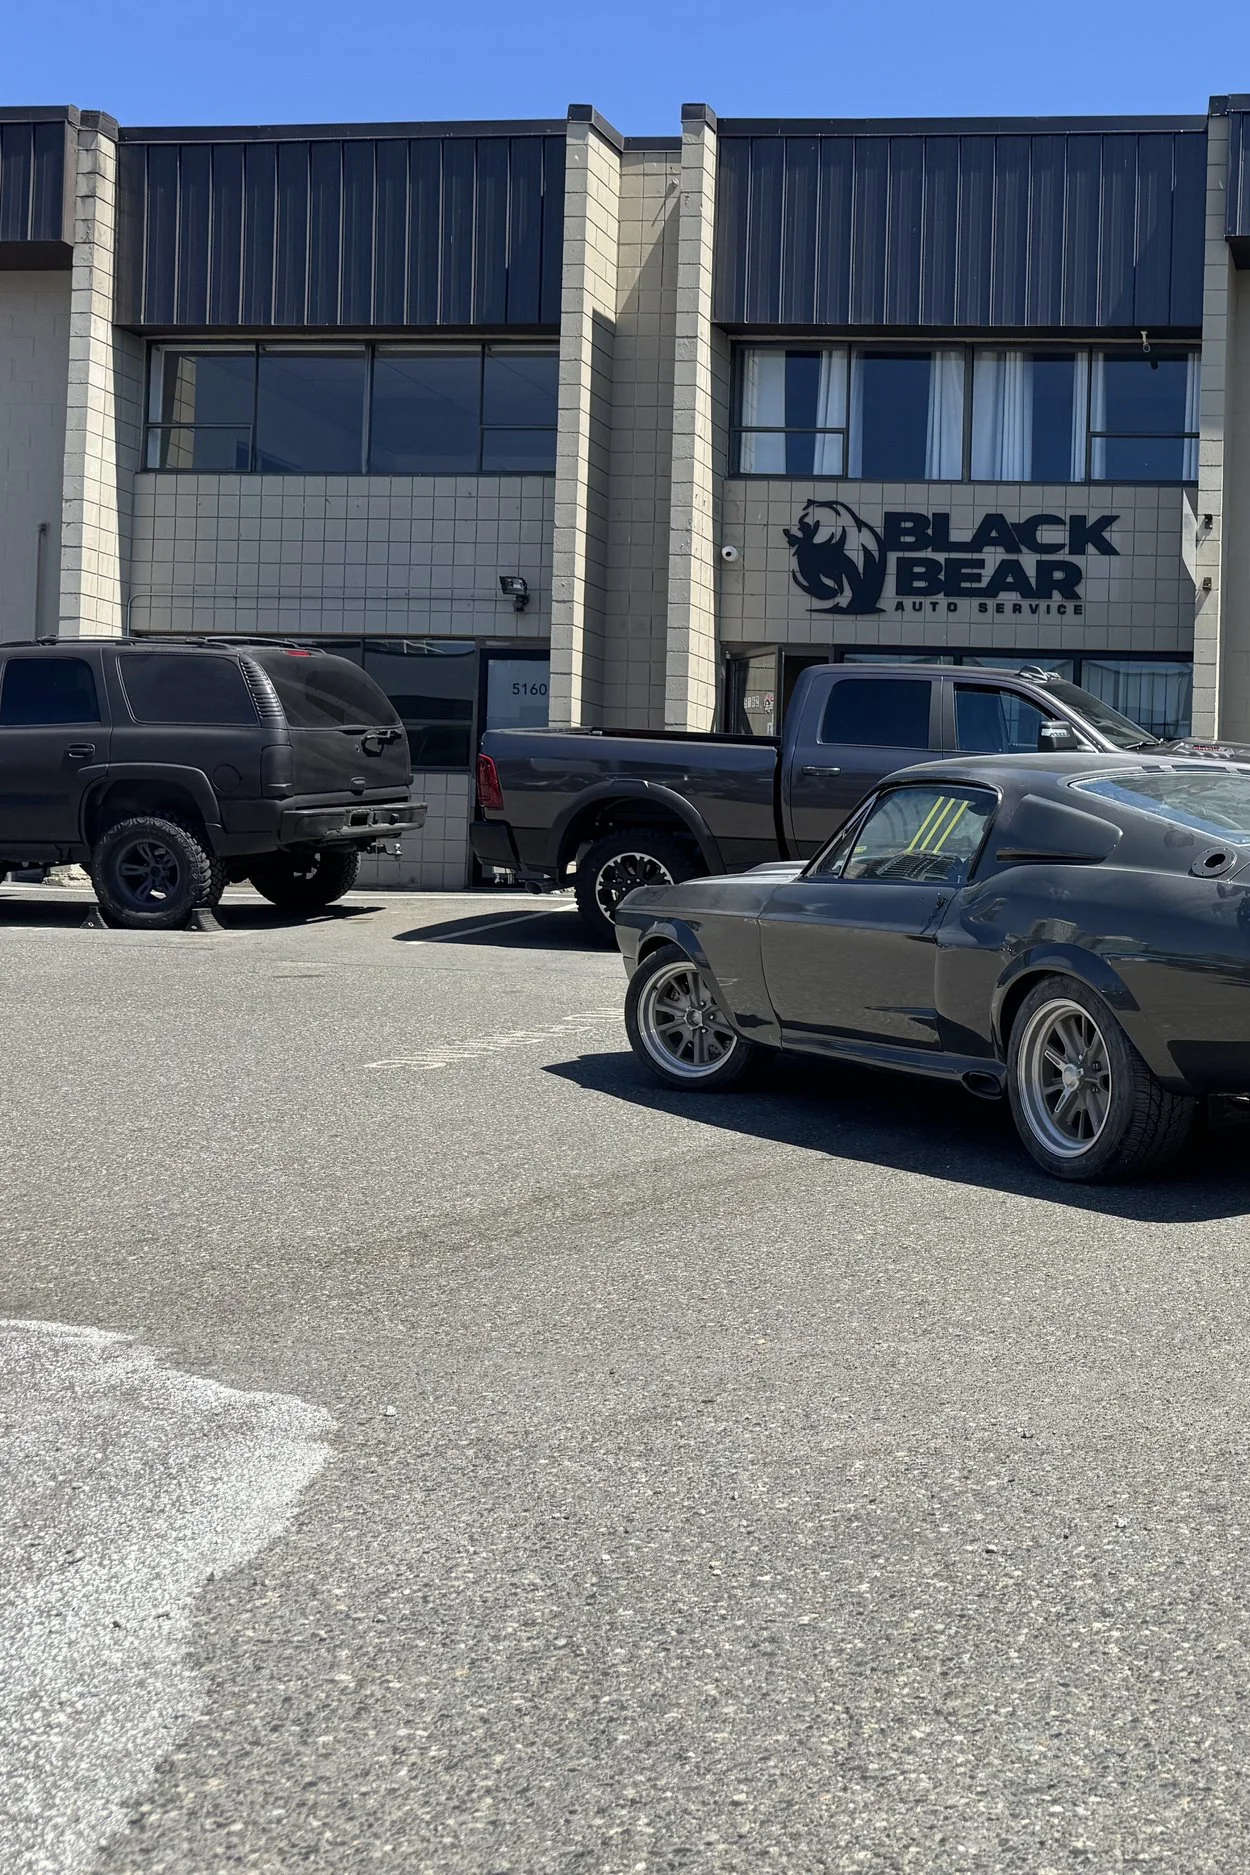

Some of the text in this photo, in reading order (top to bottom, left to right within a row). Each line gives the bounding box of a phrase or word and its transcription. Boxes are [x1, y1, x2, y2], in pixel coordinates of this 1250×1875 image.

[883, 511, 1121, 556] BLACK
[895, 556, 1083, 600] BEAR
[894, 601, 1084, 615] AUTO SERVICE
[512, 683, 547, 695] 5160
